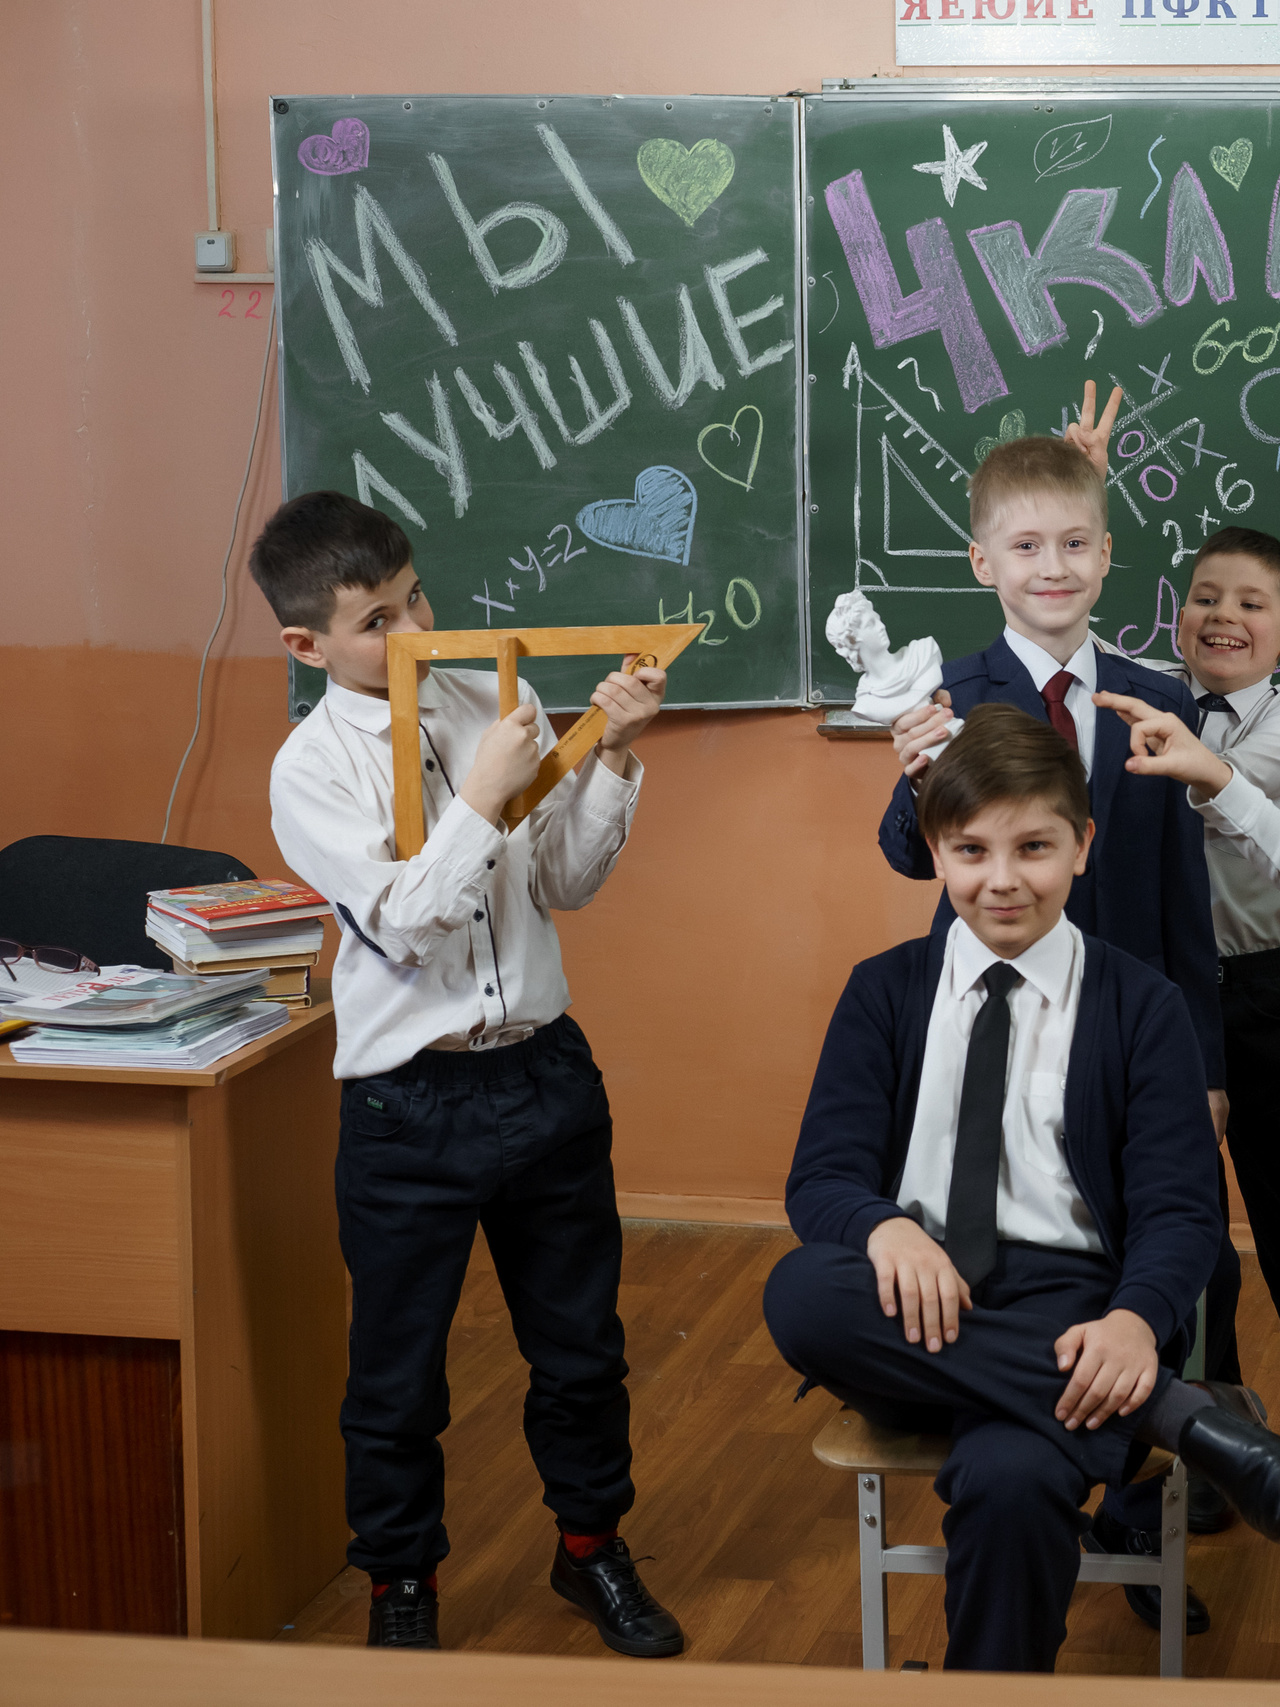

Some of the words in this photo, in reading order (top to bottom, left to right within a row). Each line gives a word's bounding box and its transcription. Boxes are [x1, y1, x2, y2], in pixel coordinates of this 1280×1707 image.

[303, 123, 635, 394] МЫ
[352, 247, 795, 530] ЛУЧШИЕ
[403, 1584, 415, 1595] M
